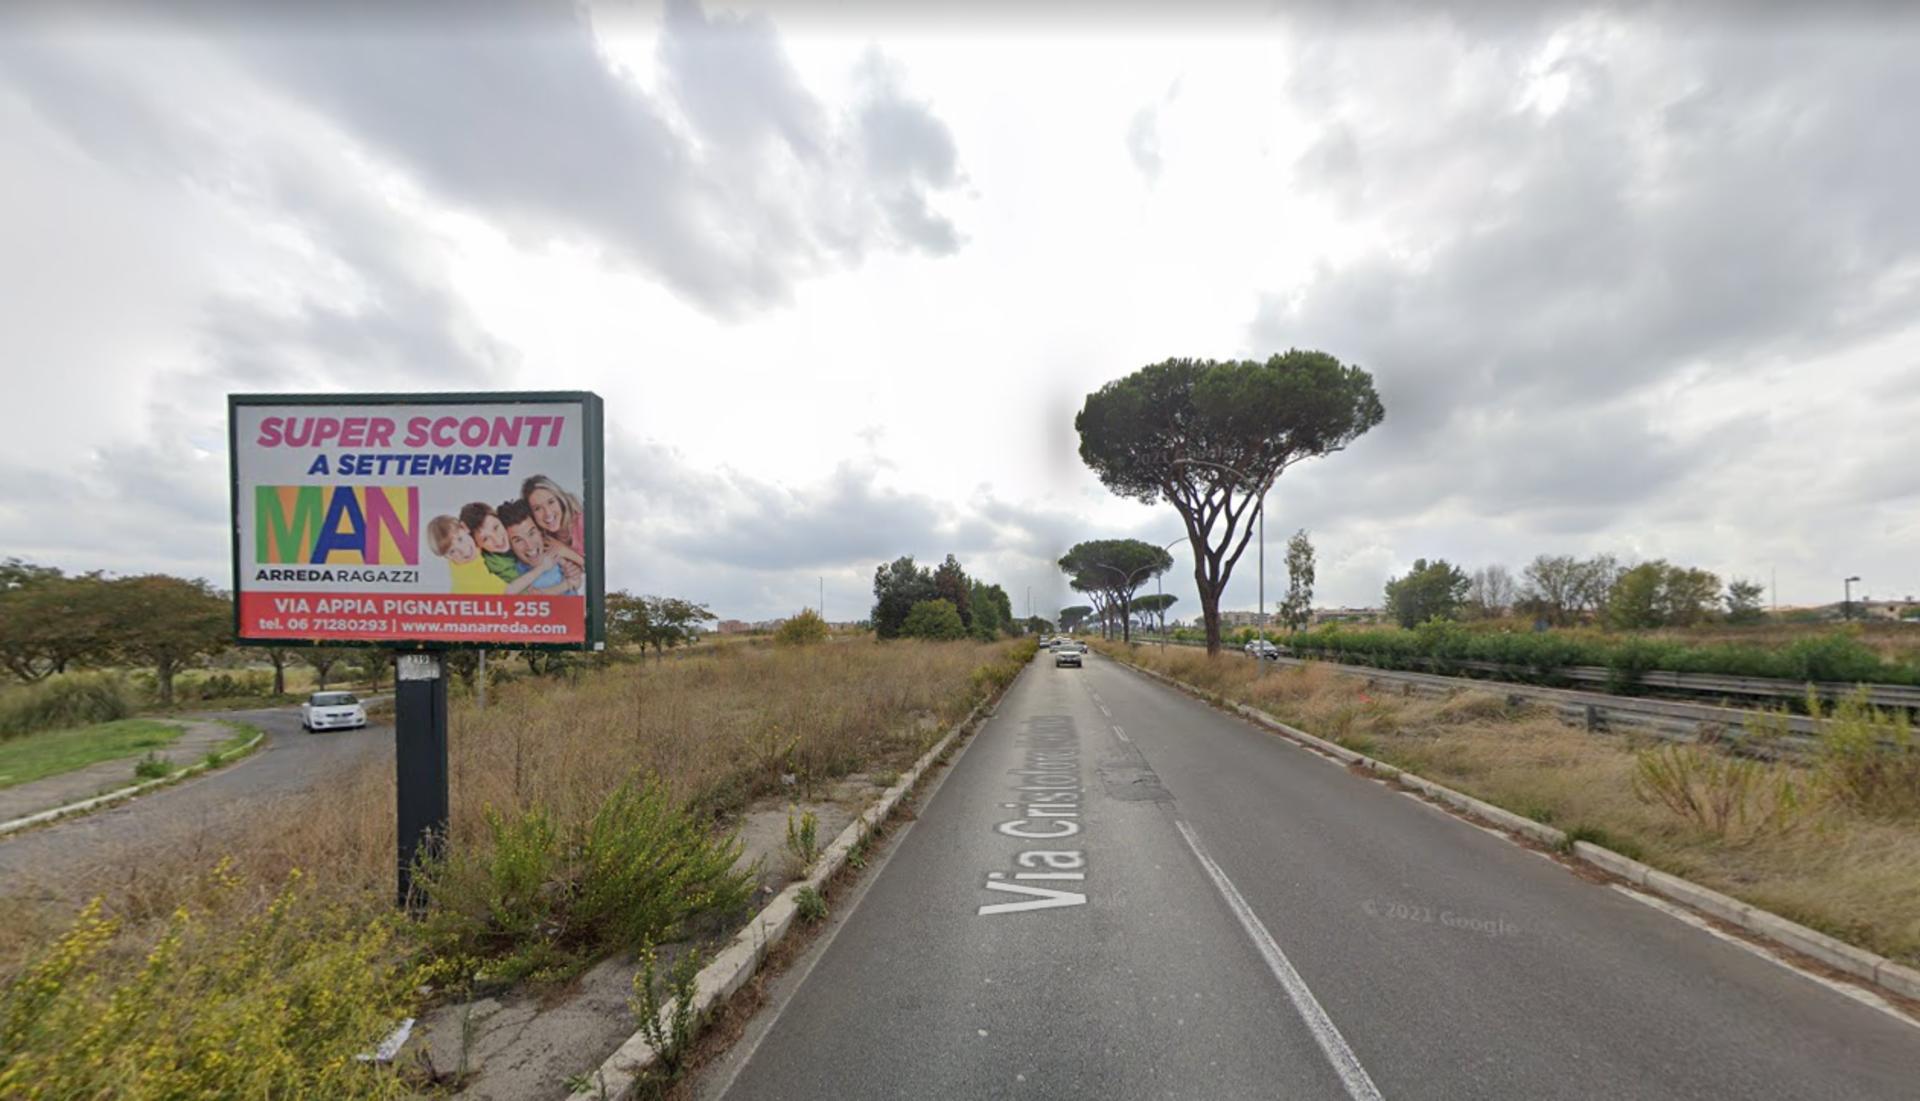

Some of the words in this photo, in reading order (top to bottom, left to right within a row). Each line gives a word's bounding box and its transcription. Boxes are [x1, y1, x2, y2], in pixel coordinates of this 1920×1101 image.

[257, 416, 396, 447] SUPER
[403, 416, 565, 447] SCONTI
[307, 453, 330, 475] A
[337, 453, 513, 476] SETTEMBRE
[255, 485, 419, 565] MAN
[274, 598, 311, 613] VIA
[316, 598, 378, 614] APPIA
[383, 599, 508, 619] PIGNATELLI,
[514, 601, 551, 617] 255
[258, 617, 284, 630] tel.
[288, 618, 308, 630] 06
[313, 619, 388, 631] 71280293
[401, 620, 568, 635] www.manarreda.com
